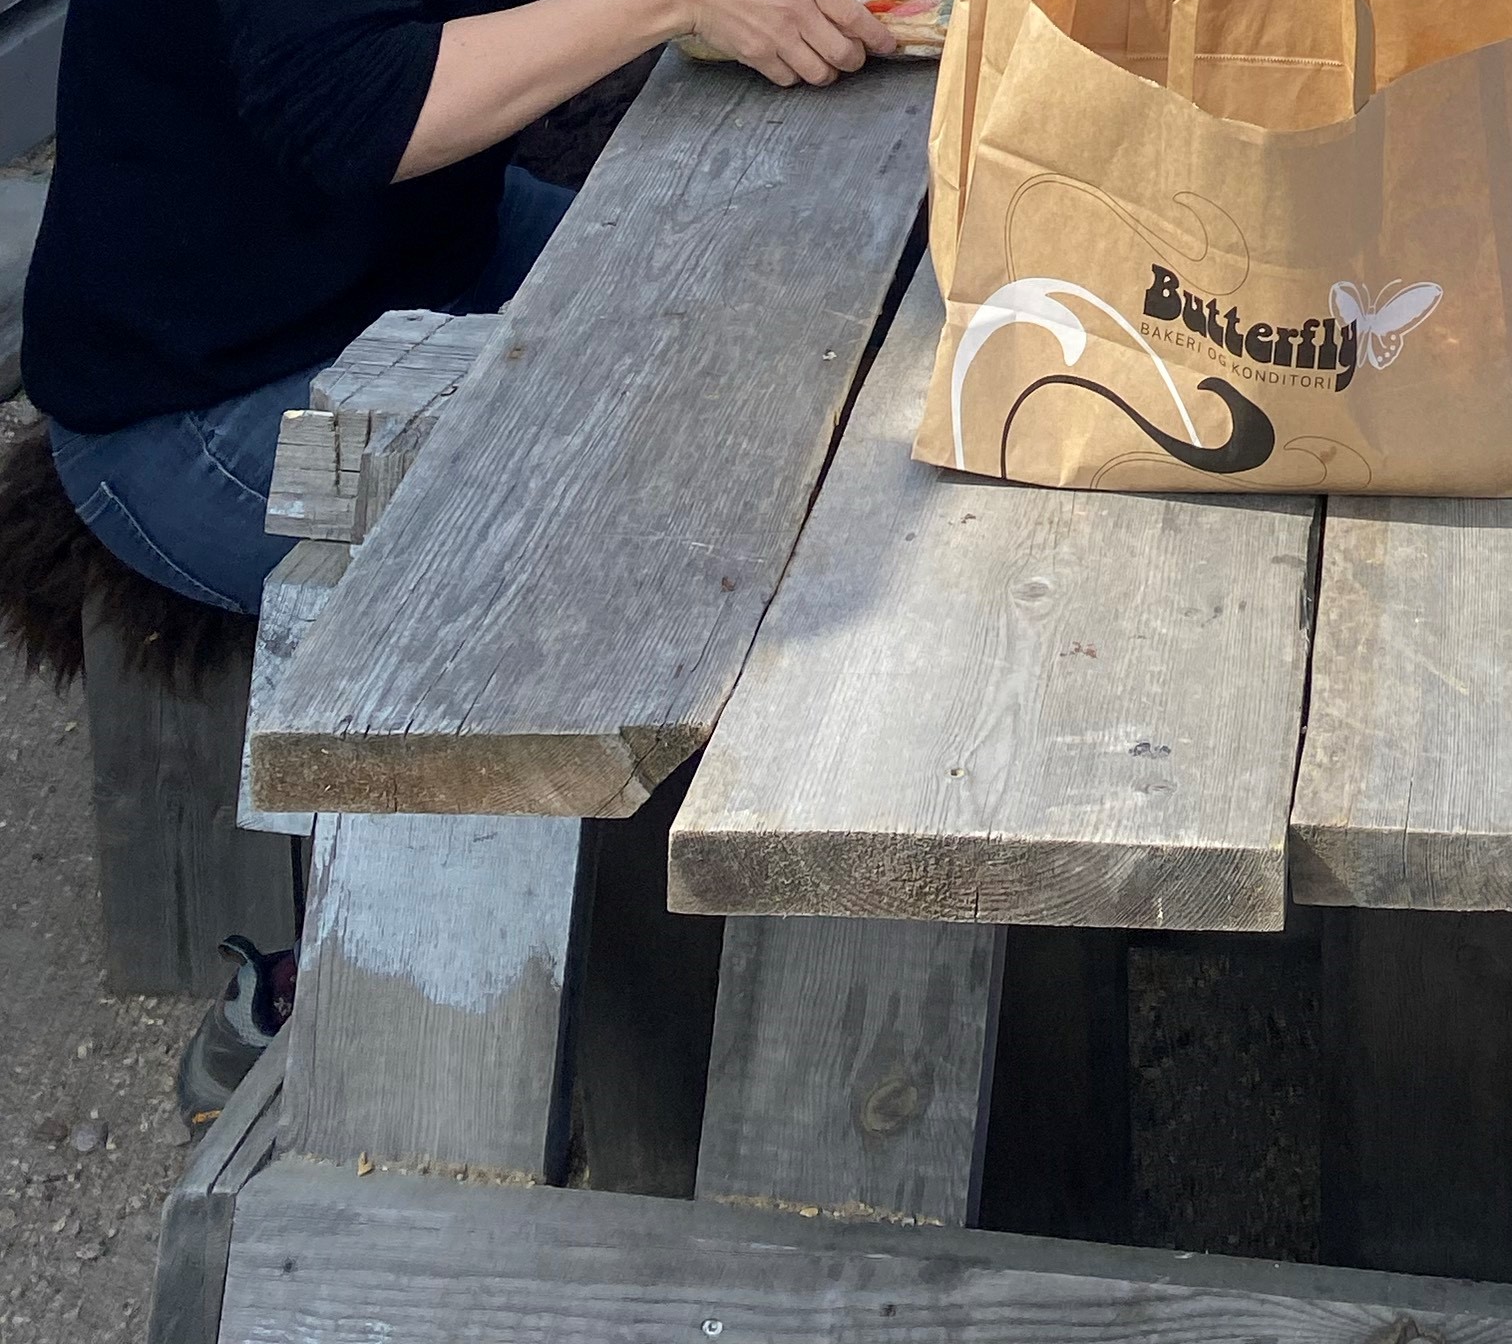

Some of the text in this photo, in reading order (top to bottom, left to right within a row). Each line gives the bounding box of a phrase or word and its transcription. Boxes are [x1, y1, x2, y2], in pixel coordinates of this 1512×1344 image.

[1140, 321, 1332, 390] BAKERI OG KONDITORI
[1142, 263, 1359, 393] Butterfly
